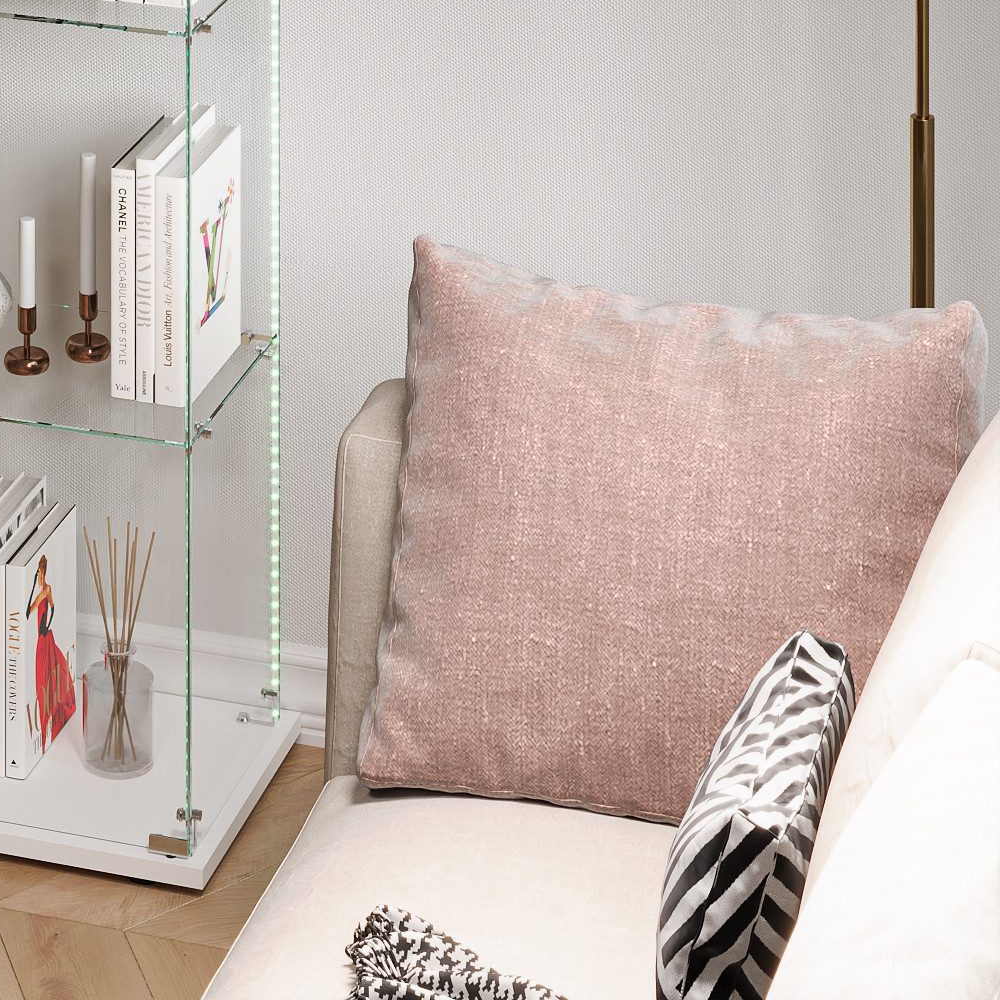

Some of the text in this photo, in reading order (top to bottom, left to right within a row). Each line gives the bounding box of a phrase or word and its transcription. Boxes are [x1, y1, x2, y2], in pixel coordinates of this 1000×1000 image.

[118, 188, 127, 233] CHANEL
[162, 193, 173, 241] Architecture
[118, 236, 127, 254] THE
[163, 241, 173, 258] and
[118, 257, 127, 320] VOCABULARY
[163, 258, 174, 290] Fashion
[136, 279, 152, 328] DIOR
[118, 322, 127, 335] OF
[163, 310, 173, 341] Vuitton
[118, 337, 127, 366] STYLE
[163, 342, 173, 367] Louis
[115, 383, 131, 392] Yale
[8, 611, 20, 721] VOGUE THE COVERS
